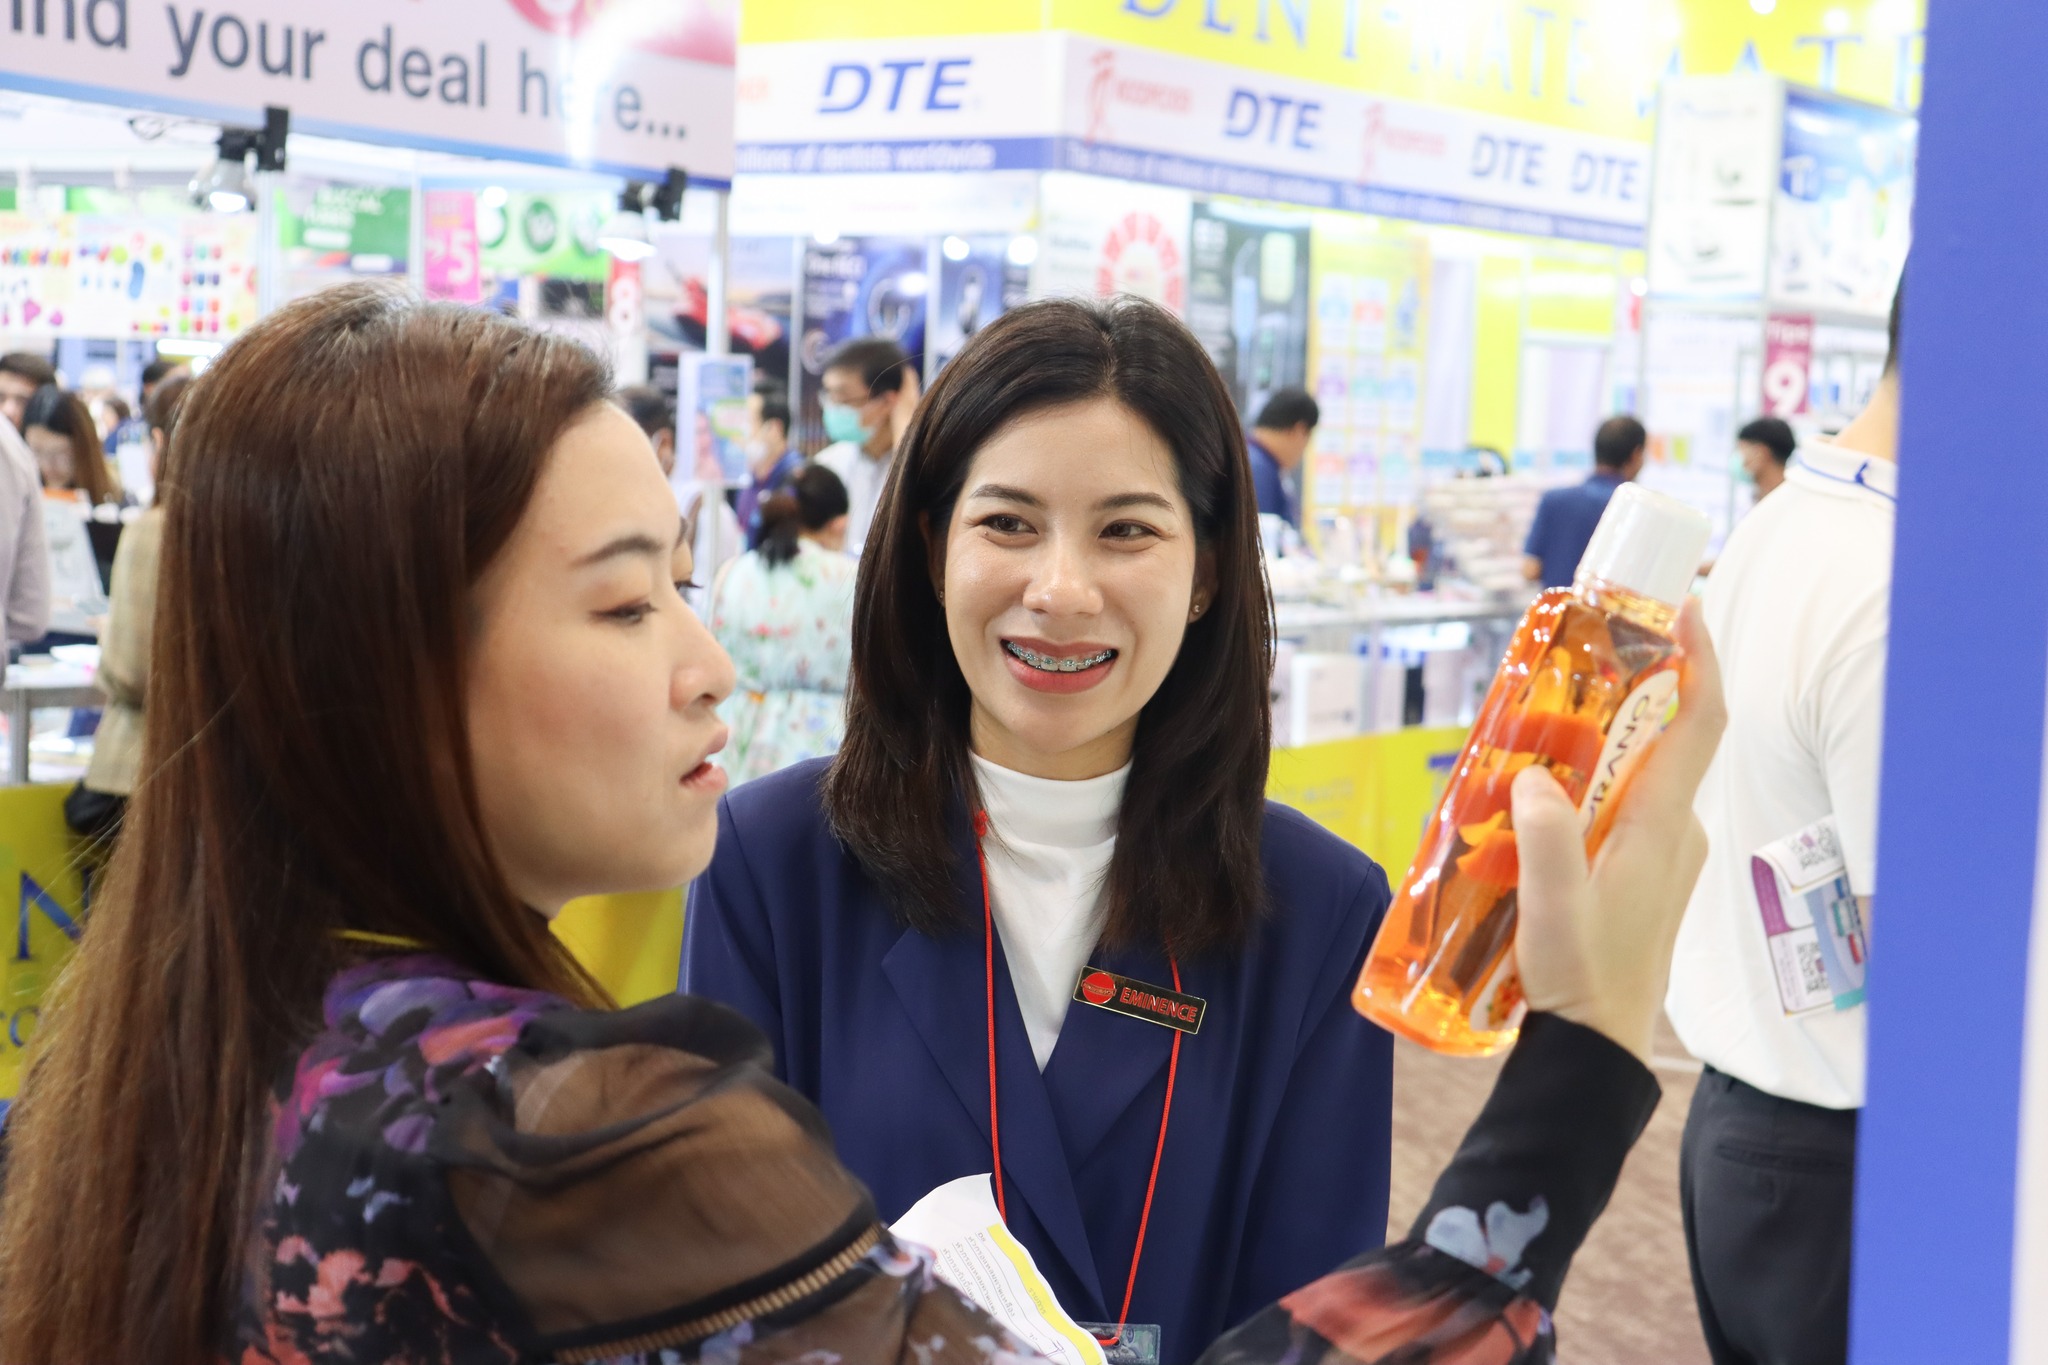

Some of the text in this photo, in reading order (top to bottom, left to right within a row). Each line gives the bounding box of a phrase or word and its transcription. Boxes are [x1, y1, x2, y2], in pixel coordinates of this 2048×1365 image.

[165, 4, 325, 79] your
[356, 22, 487, 109] deal
[816, 57, 973, 114] DTE
[1225, 87, 1323, 149] DTE
[1470, 133, 1545, 187] DTE
[1570, 152, 1639, 201] DTE
[1120, 987, 1199, 1023] EMINENCE
